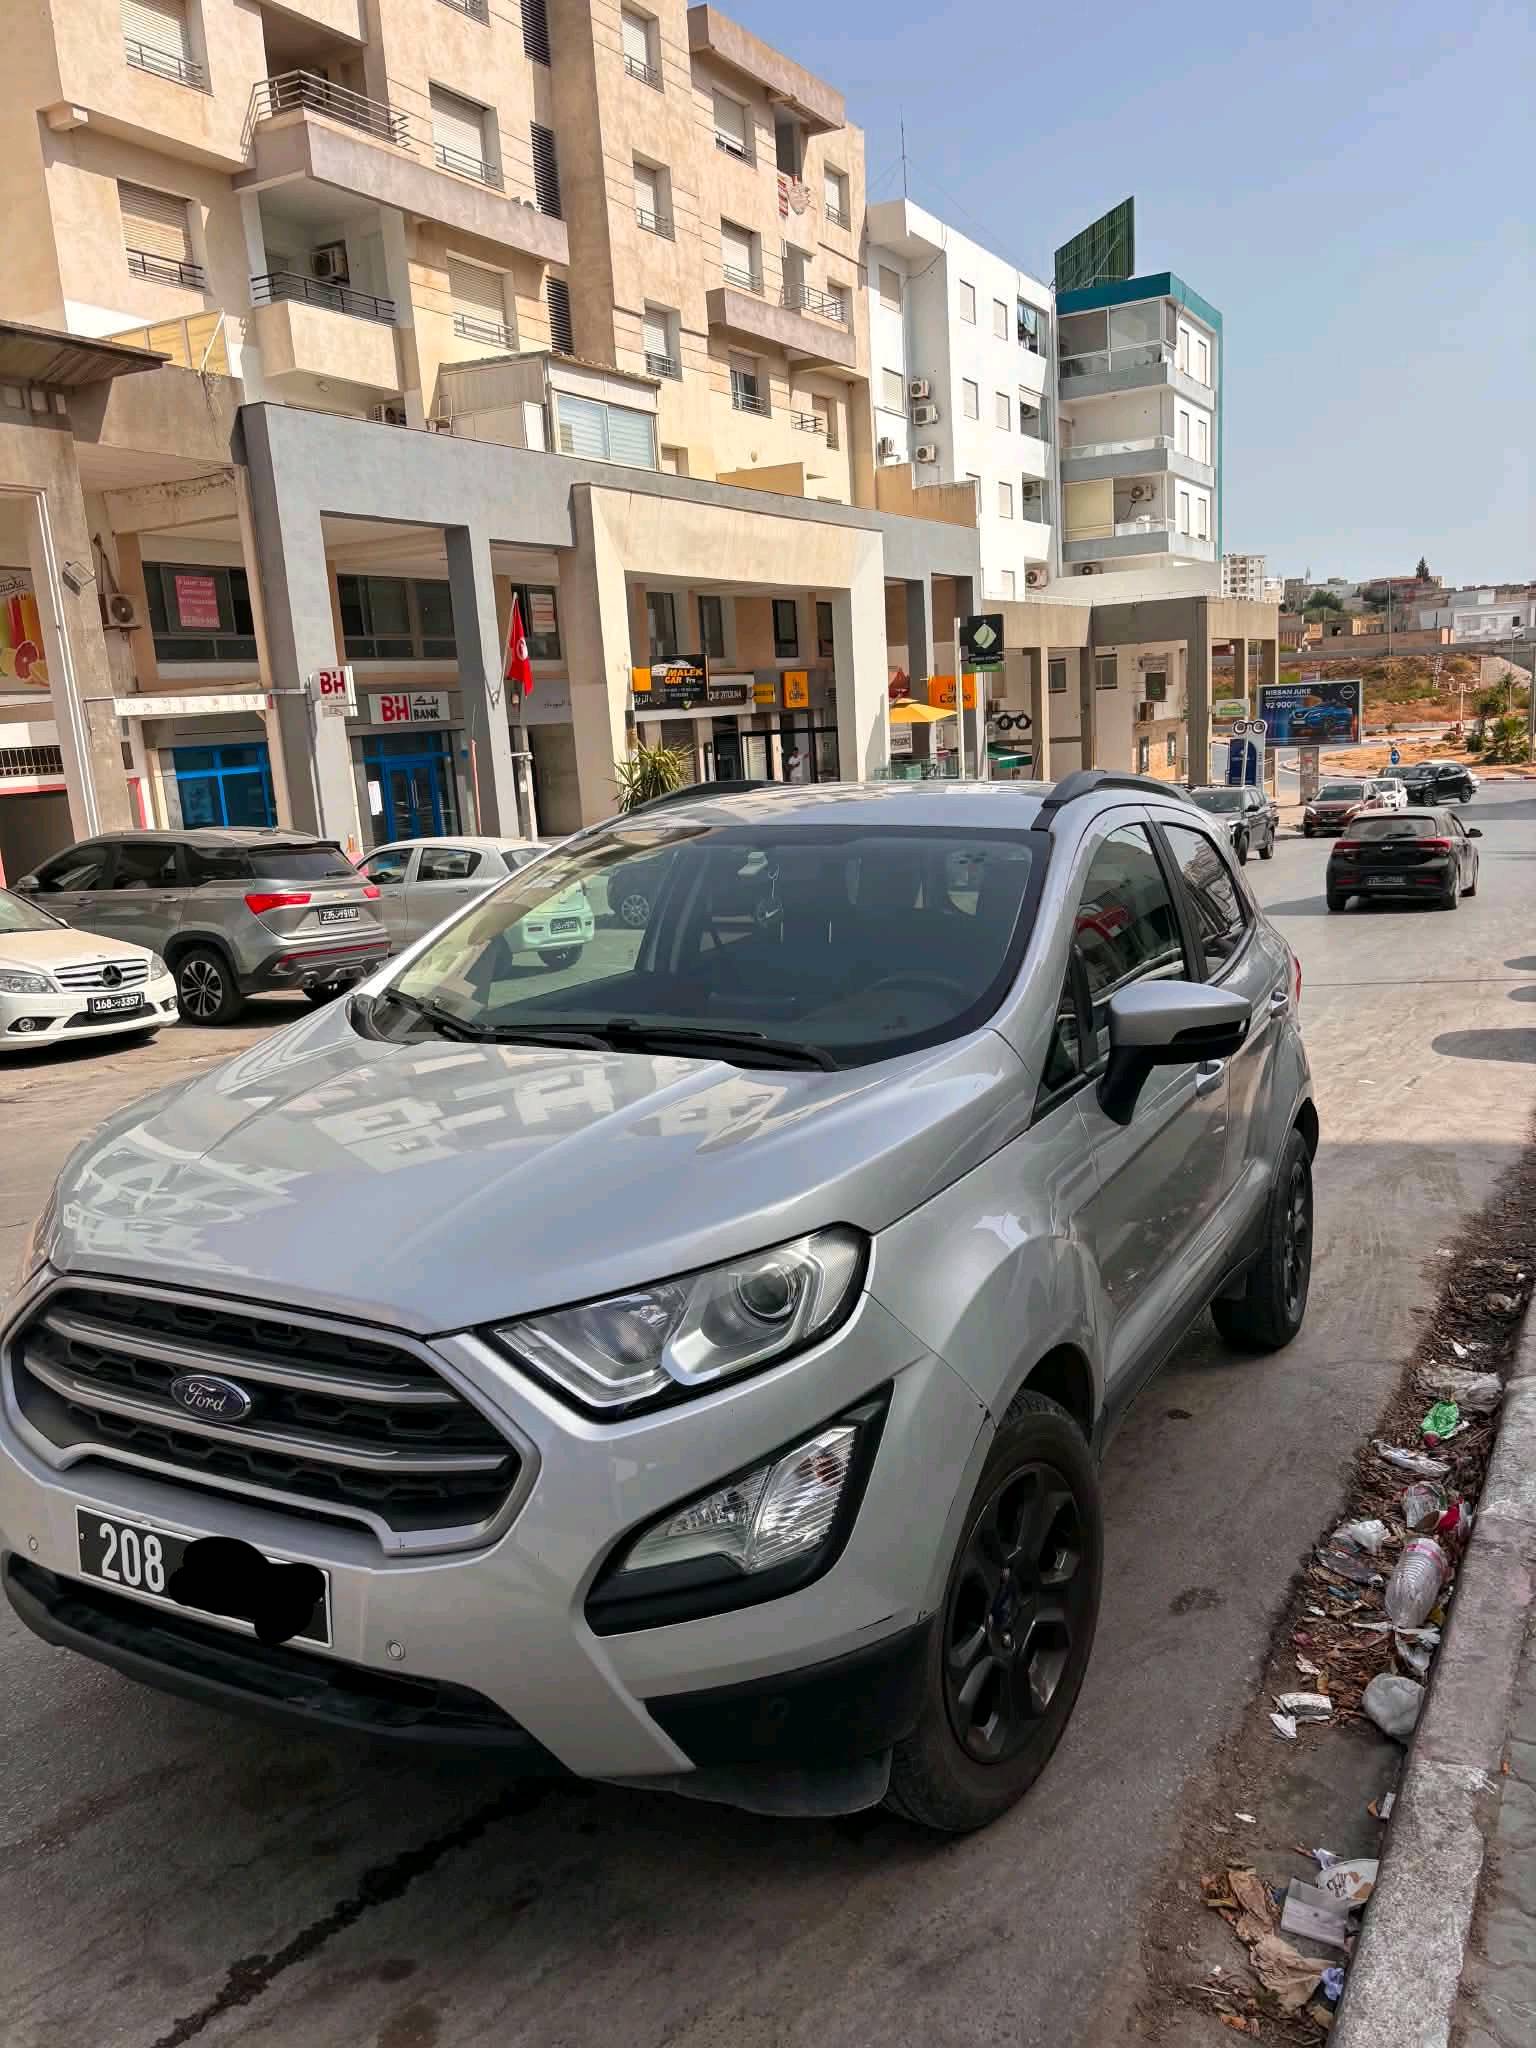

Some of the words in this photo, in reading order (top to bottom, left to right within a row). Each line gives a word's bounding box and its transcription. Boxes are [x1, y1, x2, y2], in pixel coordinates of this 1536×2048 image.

[667, 667, 703, 676] MALEK
[319, 671, 346, 695] BH
[664, 676, 682, 684] CAR
[1265, 688, 1292, 696] NISSAN
[1293, 687, 1312, 696] JUKE
[380, 695, 410, 721] BH
[1265, 701, 1275, 709] 92
[413, 707, 440, 720] BANK
[95, 999, 112, 1011] 168
[121, 995, 140, 1008] 3357
[184, 1382, 225, 1413] Ford
[99, 1522, 165, 1593] 208
